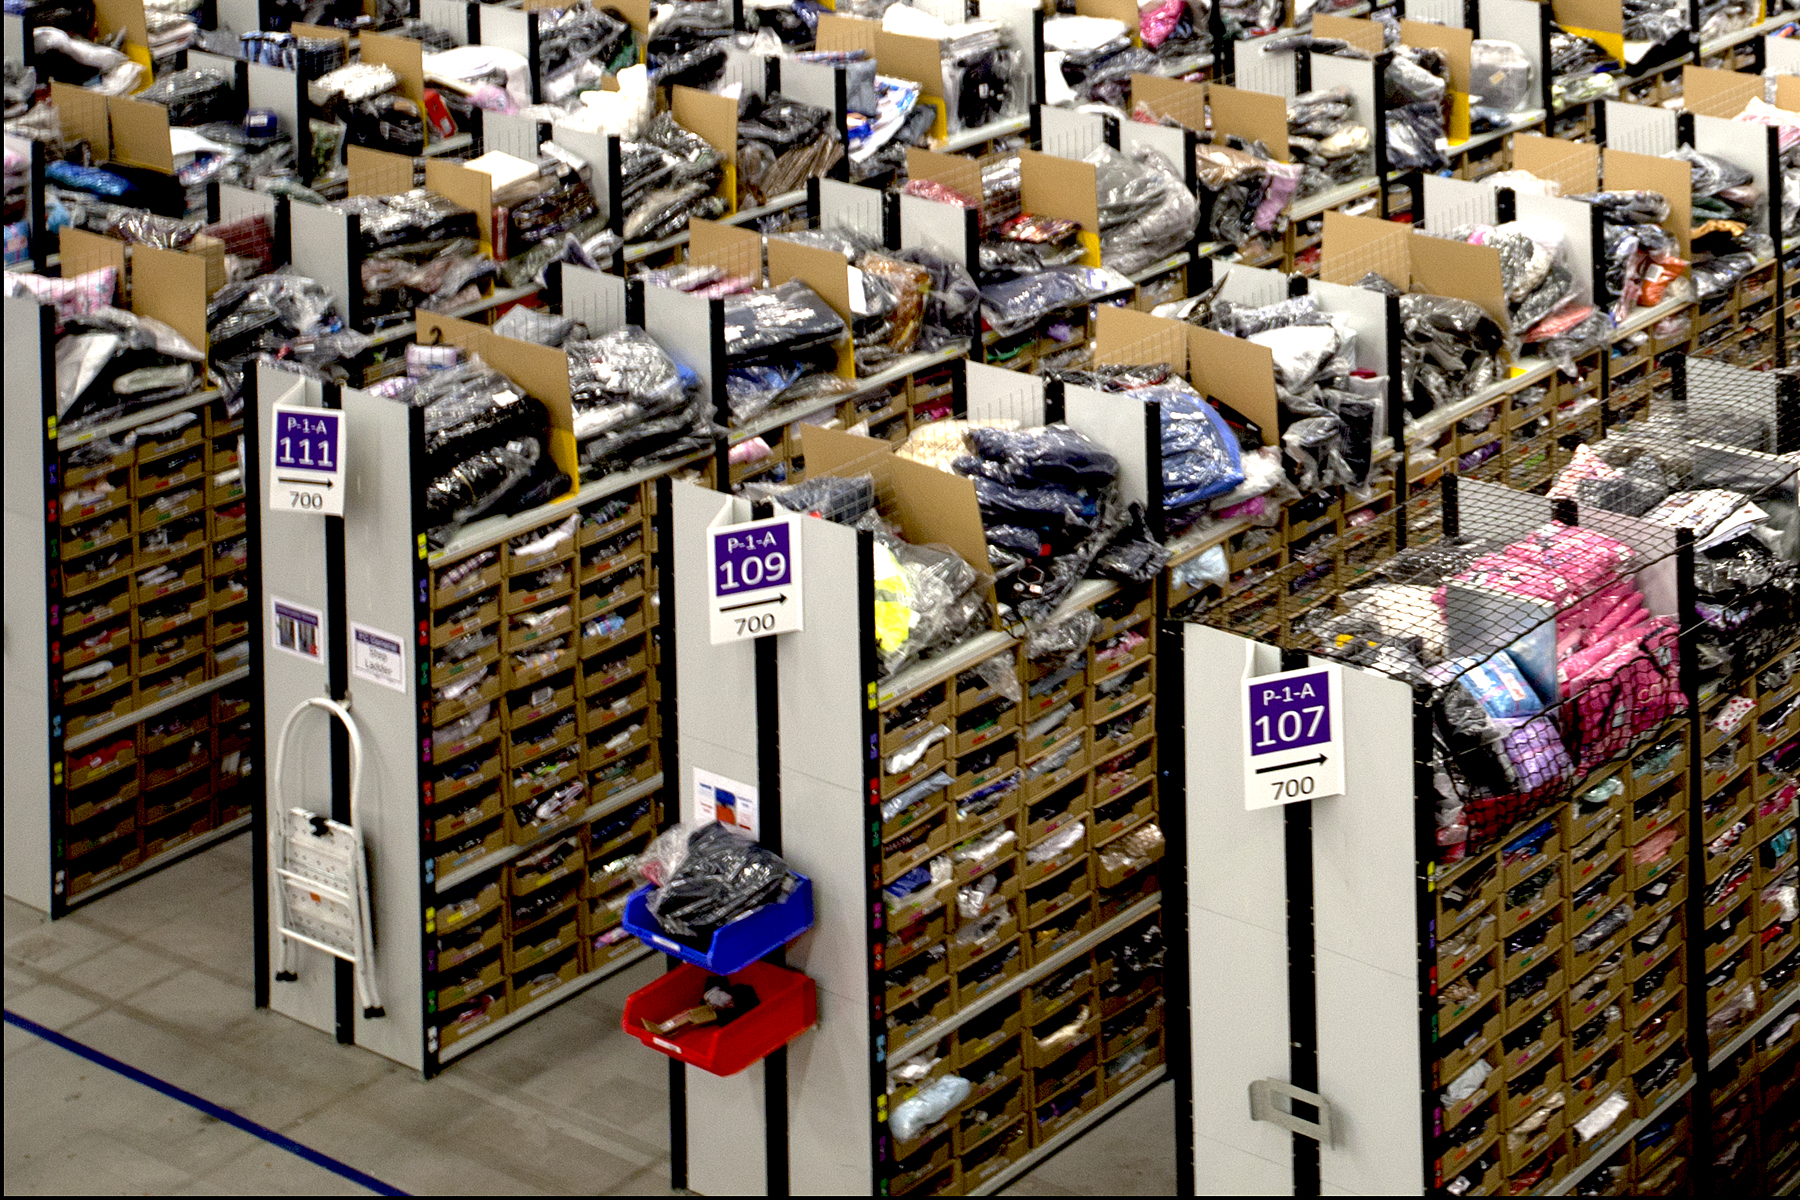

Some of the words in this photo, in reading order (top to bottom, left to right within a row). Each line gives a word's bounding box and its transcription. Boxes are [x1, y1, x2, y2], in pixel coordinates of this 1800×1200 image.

[287, 416, 328, 435] P-1-A
[279, 436, 334, 468] 111
[289, 490, 324, 510] 700
[727, 531, 777, 554] P-1-A
[719, 552, 787, 591] 109
[734, 612, 776, 636] 700
[1262, 682, 1316, 706] P-1-A
[1254, 705, 1326, 748] 107
[1270, 775, 1315, 801] 700
